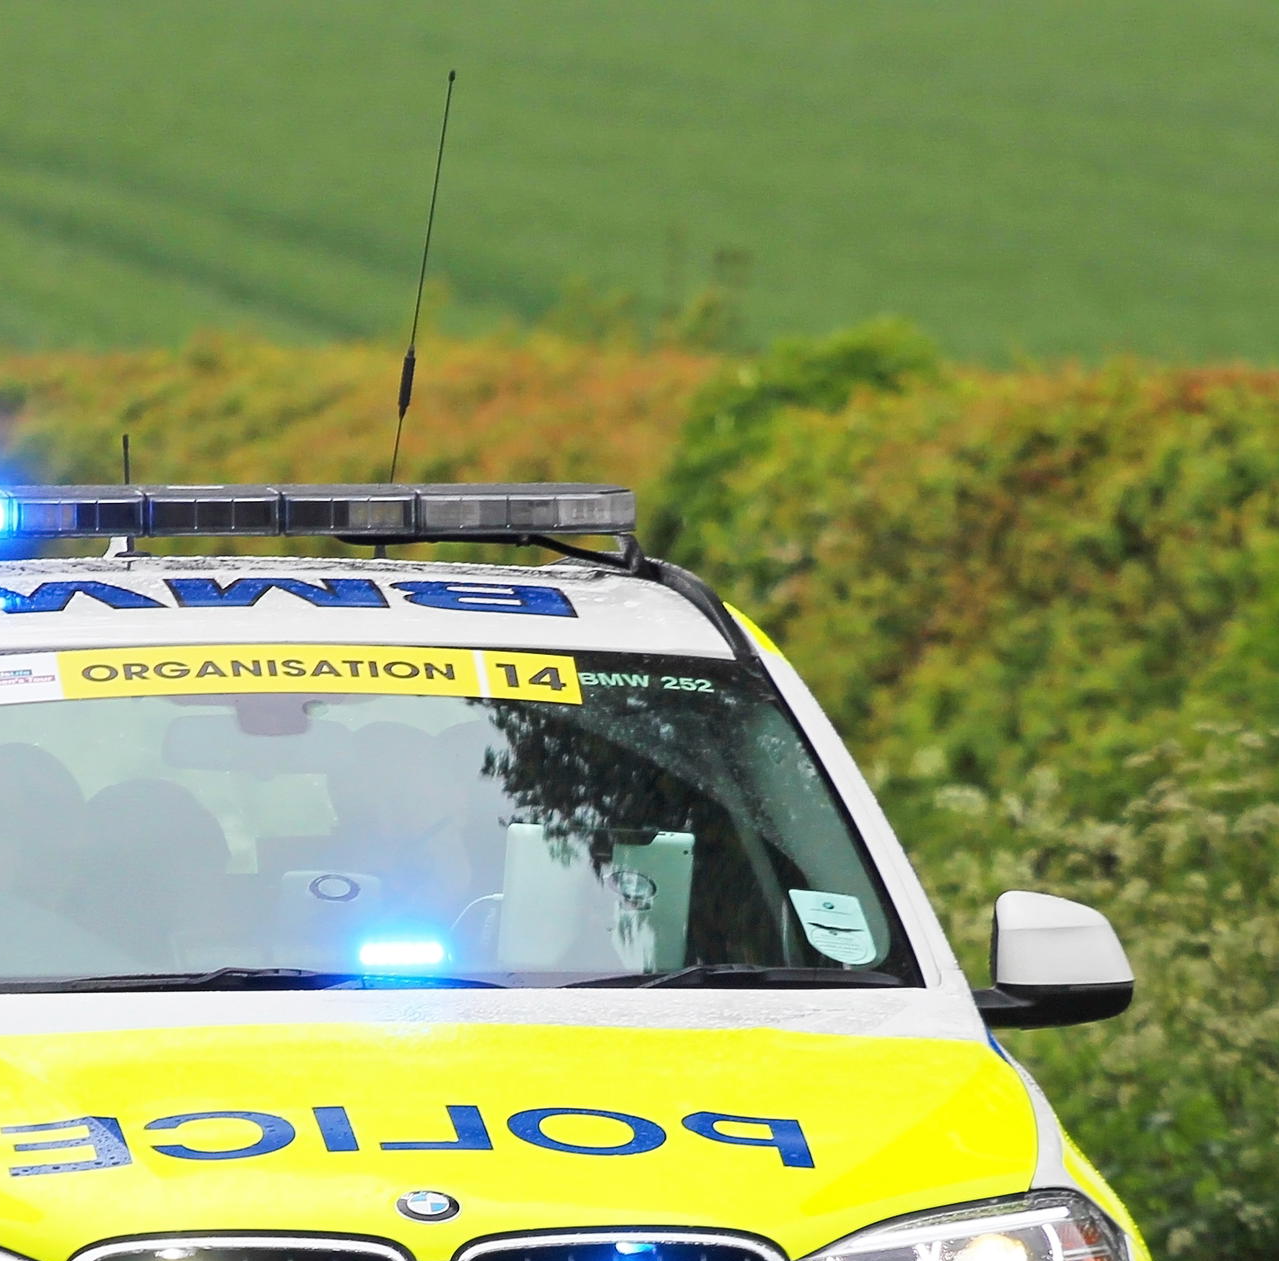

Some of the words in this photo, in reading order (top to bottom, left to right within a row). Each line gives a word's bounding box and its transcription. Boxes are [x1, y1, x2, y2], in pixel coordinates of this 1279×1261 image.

[81, 659, 456, 682] ORGANISATION
[495, 662, 567, 692] 14
[578, 671, 649, 688] BMW
[660, 675, 715, 693] 252
